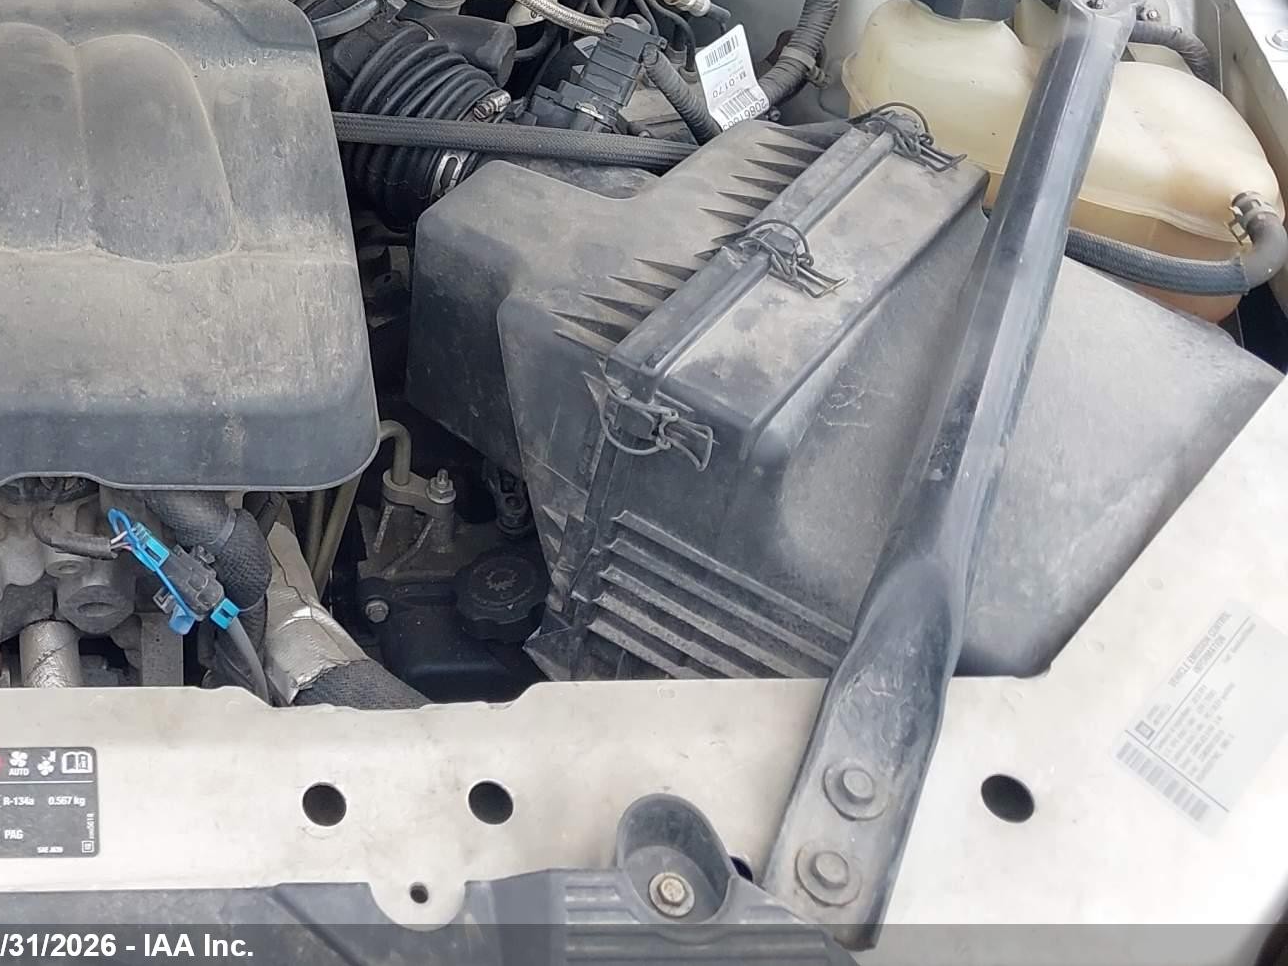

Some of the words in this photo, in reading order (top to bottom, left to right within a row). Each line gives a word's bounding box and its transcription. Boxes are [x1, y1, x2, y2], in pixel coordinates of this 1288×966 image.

[1169, 662, 1191, 689] VEHICLE
[9, 768, 30, 776] AUTO
[3, 797, 35, 806] R-134a
[73, 797, 86, 807] kg
[4, 830, 24, 840] PAG
